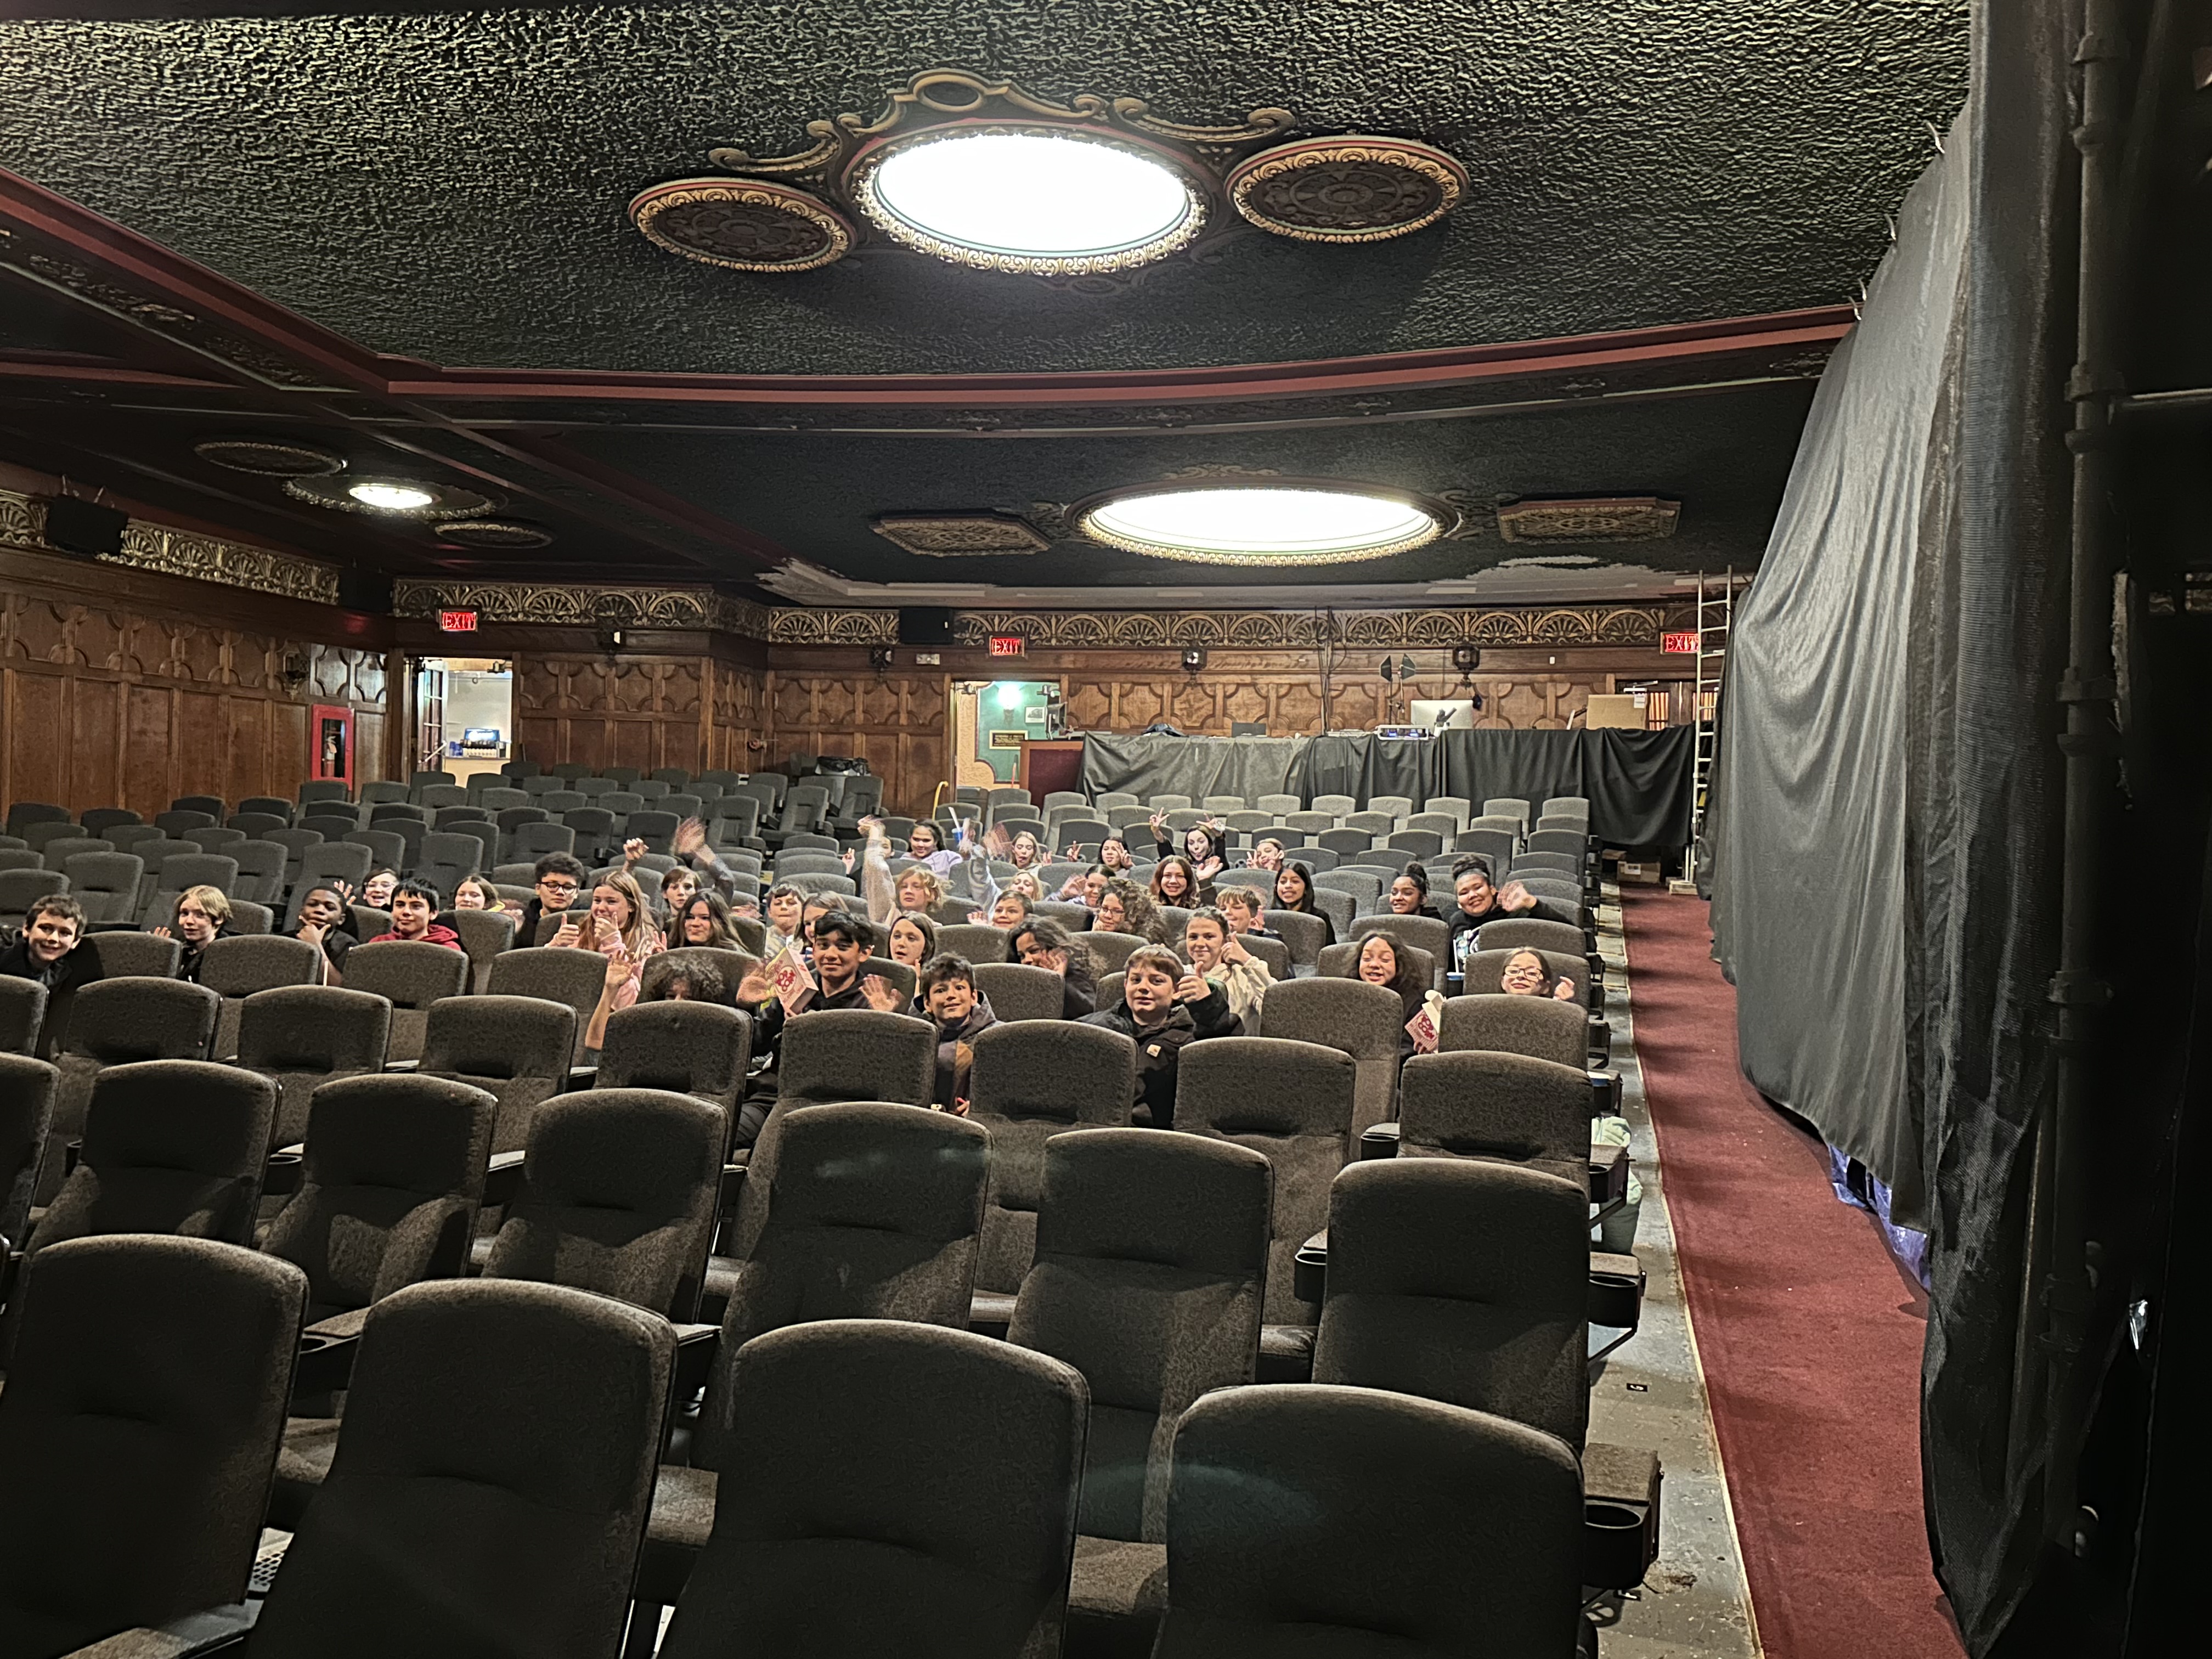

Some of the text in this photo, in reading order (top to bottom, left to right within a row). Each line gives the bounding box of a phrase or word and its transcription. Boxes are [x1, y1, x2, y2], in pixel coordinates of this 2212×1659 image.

[445, 613, 474, 628] EXIT
[994, 640, 1020, 654] EXIT
[1666, 635, 1697, 651] EXIT
